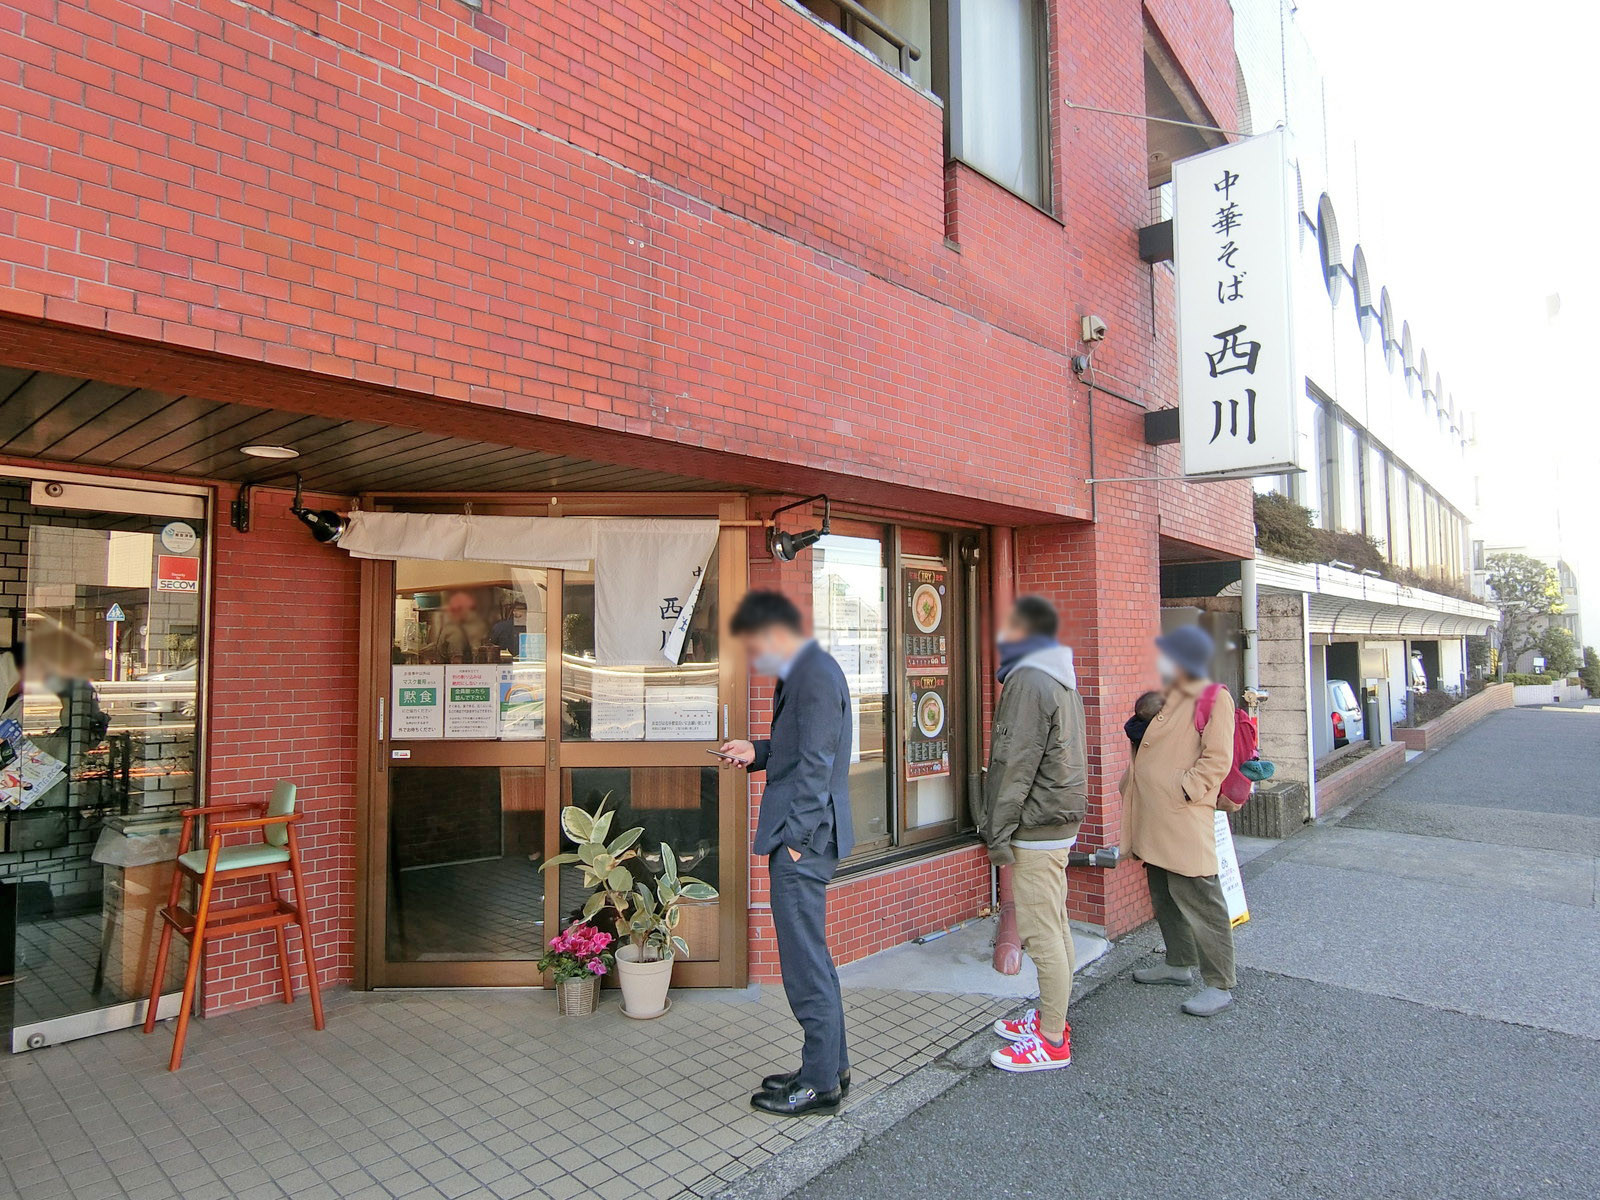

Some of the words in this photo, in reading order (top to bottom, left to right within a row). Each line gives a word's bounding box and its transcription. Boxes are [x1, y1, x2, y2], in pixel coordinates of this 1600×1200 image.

[1211, 170, 1247, 304] 中華そば
[1204, 324, 1262, 445] 西川
[160, 580, 196, 590] SECOM
[403, 690, 433, 704] 黙食
